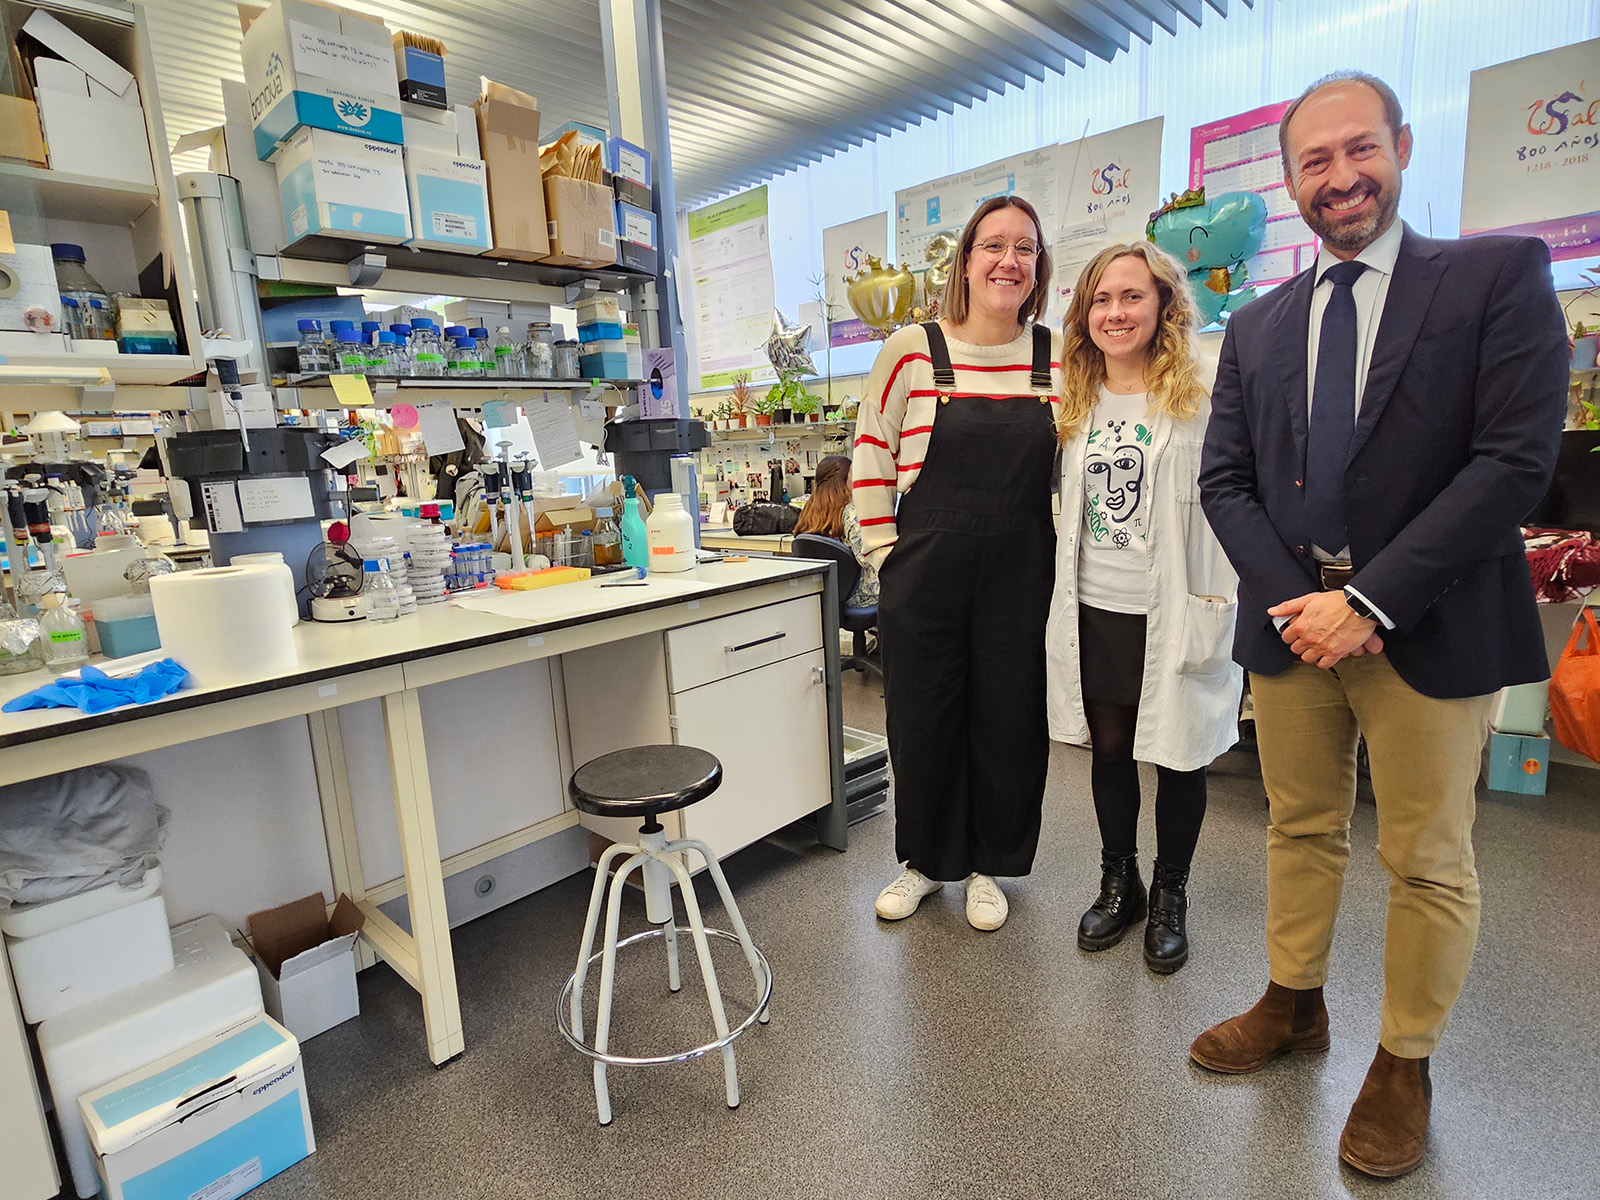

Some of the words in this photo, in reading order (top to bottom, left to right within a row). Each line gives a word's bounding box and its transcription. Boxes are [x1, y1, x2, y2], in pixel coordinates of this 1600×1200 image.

[326, 88, 357, 100] COMPROMISO
[358, 95, 376, 105] BONOVA
[364, 143, 397, 155] eppendorf
[1516, 145, 1547, 162] 800
[452, 160, 482, 171] eppendorf
[1526, 159, 1552, 174] 1218
[1562, 154, 1590, 167] 2018
[932, 179, 950, 192] Table
[951, 176, 960, 185] of
[961, 173, 973, 183] the
[974, 164, 1006, 179] Elements
[1086, 201, 1104, 214] 800
[660, 399, 673, 416] XS
[252, 1065, 296, 1095] eppendorf
